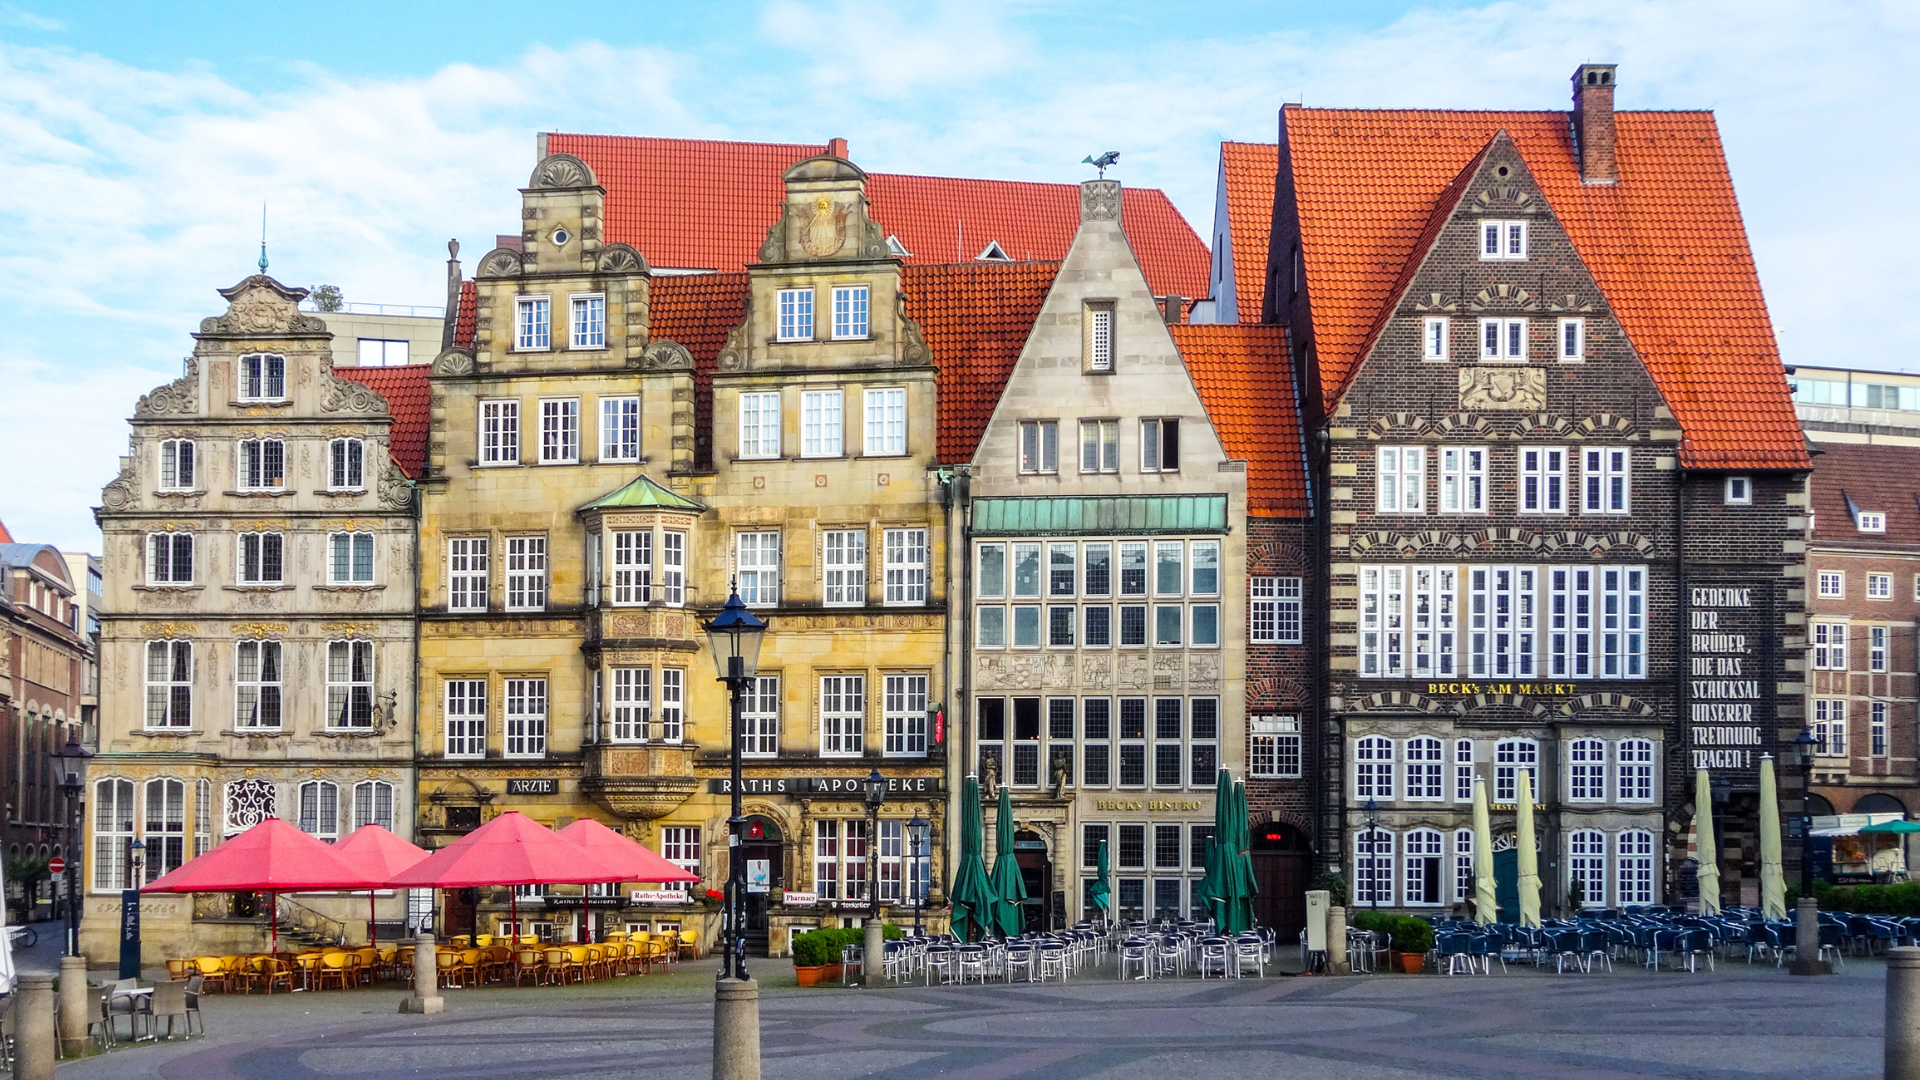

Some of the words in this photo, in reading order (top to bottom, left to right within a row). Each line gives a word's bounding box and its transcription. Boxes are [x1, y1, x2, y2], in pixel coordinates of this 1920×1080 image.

[1692, 588, 1751, 607] GEDENKE
[1692, 611, 1718, 630] DER
[1692, 631, 1752, 654] BRÜDER,
[1692, 657, 1713, 676] DIE
[1717, 657, 1742, 676] DAS
[1487, 683, 1511, 694] AM
[1518, 683, 1576, 694] MARKT
[1692, 680, 1761, 699] SCHICKSAL
[1692, 703, 1752, 722] UNSERER
[1692, 726, 1762, 745] TRENNUNG
[1692, 749, 1742, 768] TRAGEN
[512, 780, 551, 793] ÄRZTE
[1149, 800, 1202, 811] BISTRO
[635, 892, 684, 900] Raths-Apotheke
[786, 894, 815, 902] Pharmacy
